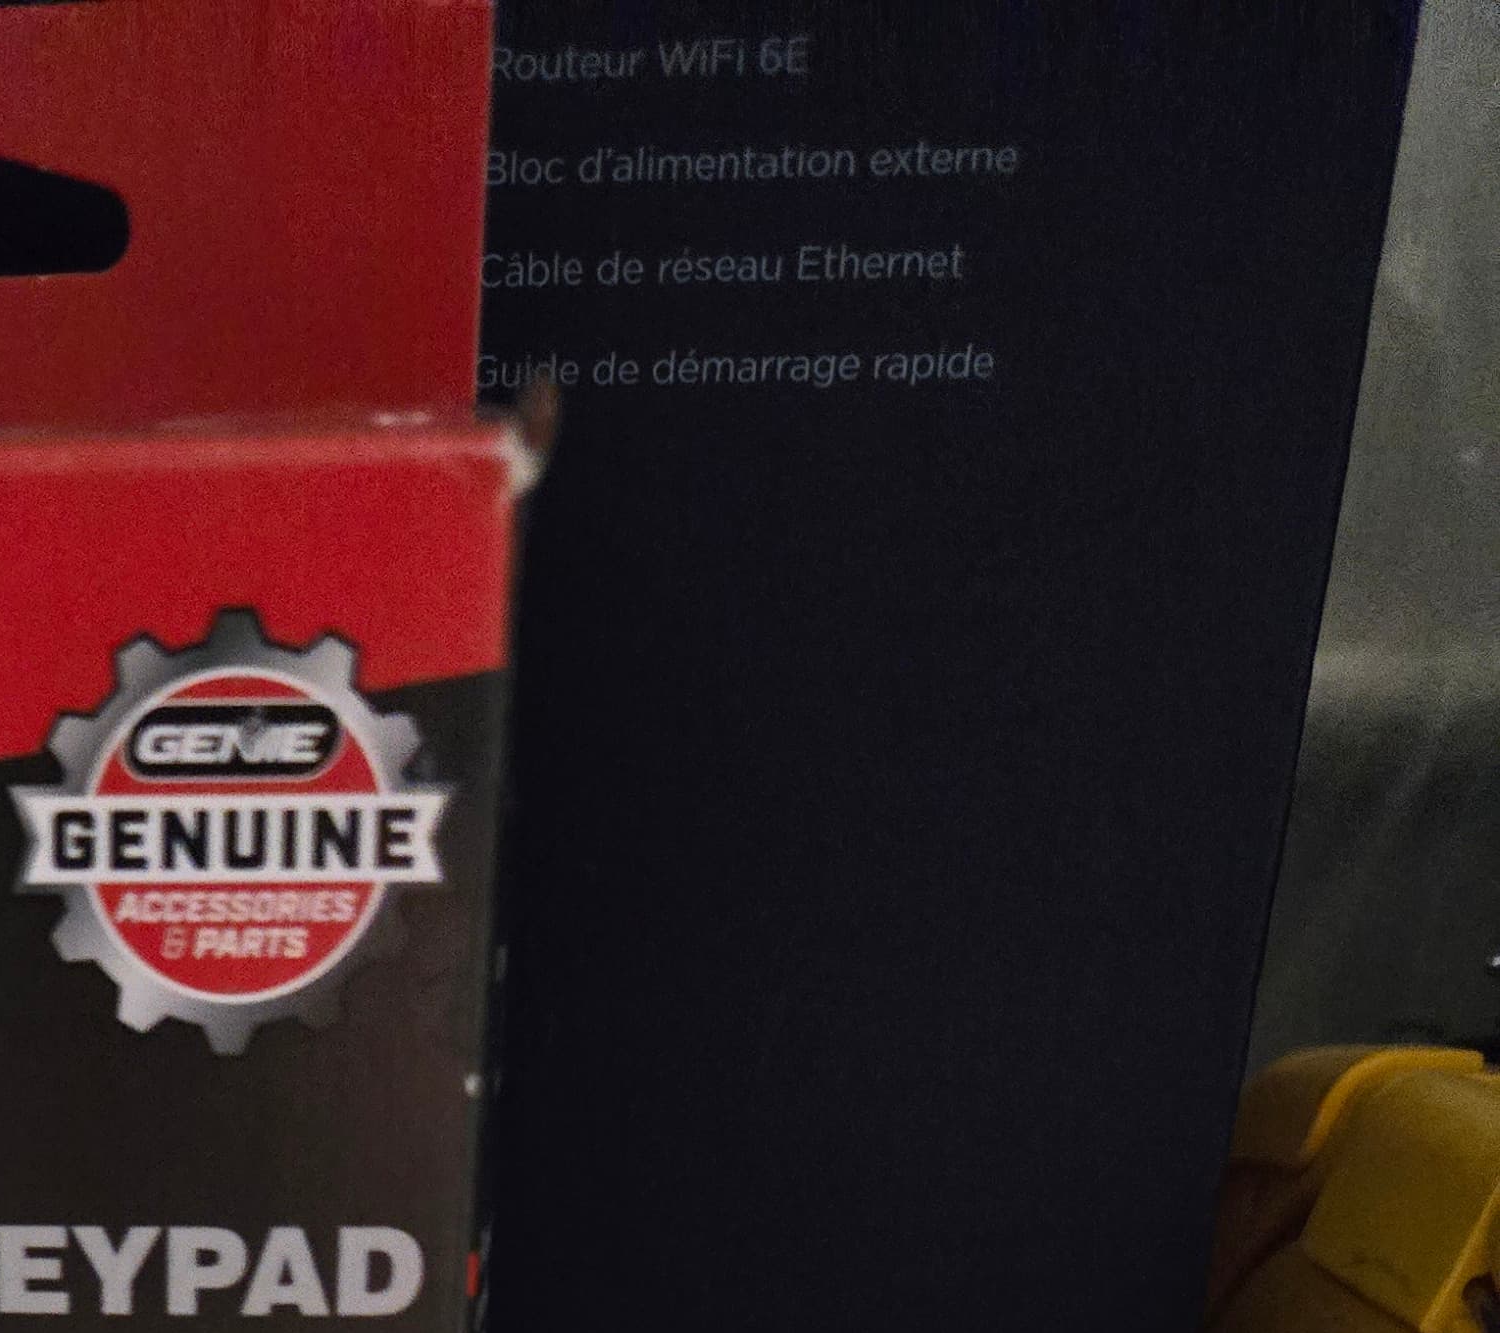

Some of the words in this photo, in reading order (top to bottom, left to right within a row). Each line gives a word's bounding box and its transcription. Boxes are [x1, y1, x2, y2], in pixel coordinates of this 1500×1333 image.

[491, 46, 645, 80] Routeur
[659, 38, 746, 77] WiFi
[759, 37, 811, 75] 6E
[485, 150, 565, 185] Bloc
[870, 142, 1018, 177] externe
[480, 250, 583, 288] Câble
[596, 250, 644, 286] de
[659, 247, 782, 284] réseau
[798, 243, 963, 281] Ethernet
[476, 352, 580, 388] Guide
[592, 351, 639, 385] de
[652, 348, 861, 389] démarrage
[874, 343, 996, 386] rapide
[134, 722, 330, 766] GENIE
[52, 808, 417, 872] GENUINE
[113, 891, 357, 923] ACCESSORIES
[193, 927, 308, 959] PARTS
